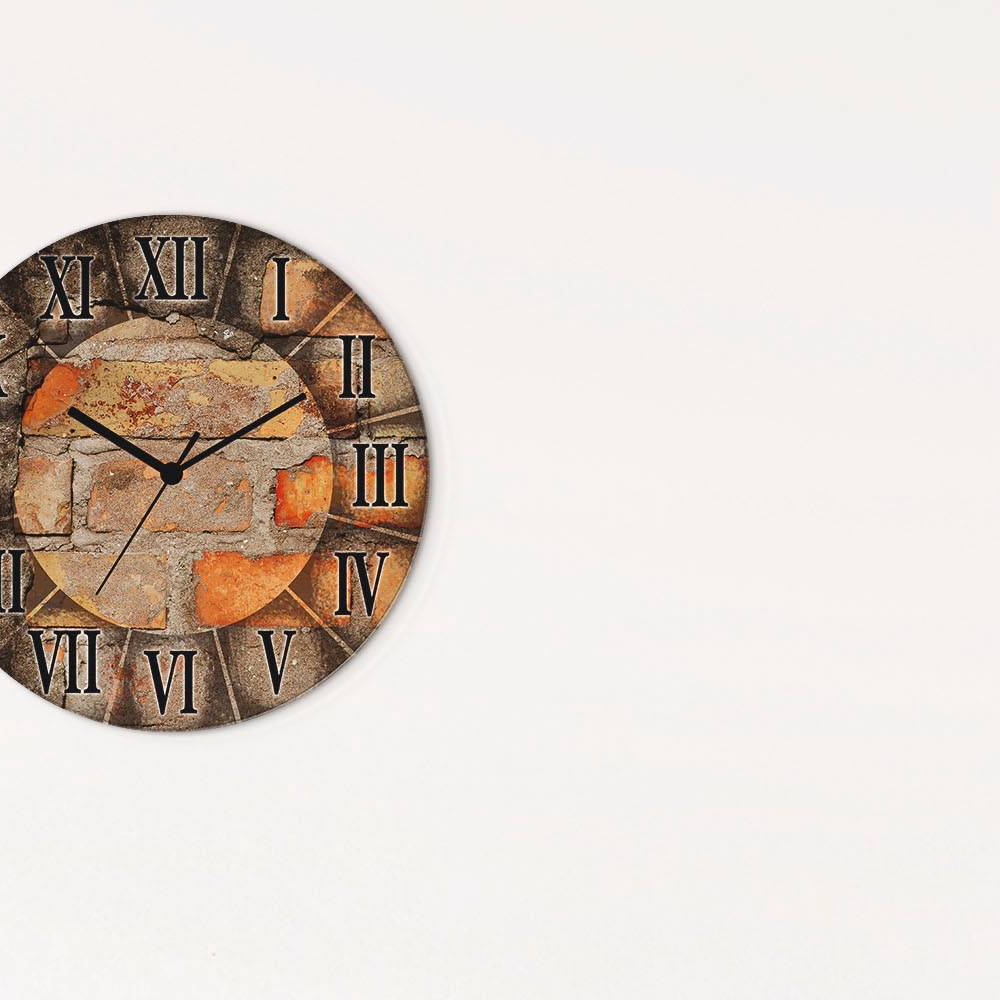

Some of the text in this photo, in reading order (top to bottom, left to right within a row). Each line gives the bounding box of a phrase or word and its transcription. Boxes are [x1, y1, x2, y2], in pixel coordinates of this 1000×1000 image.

[39, 255, 95, 321] XI
[134, 236, 209, 301] XII
[271, 257, 291, 321] I
[338, 334, 377, 399] II
[352, 443, 409, 508] III
[333, 551, 390, 618] IV
[27, 630, 102, 695] VII
[143, 650, 198, 716] VI
[257, 630, 298, 696] V
